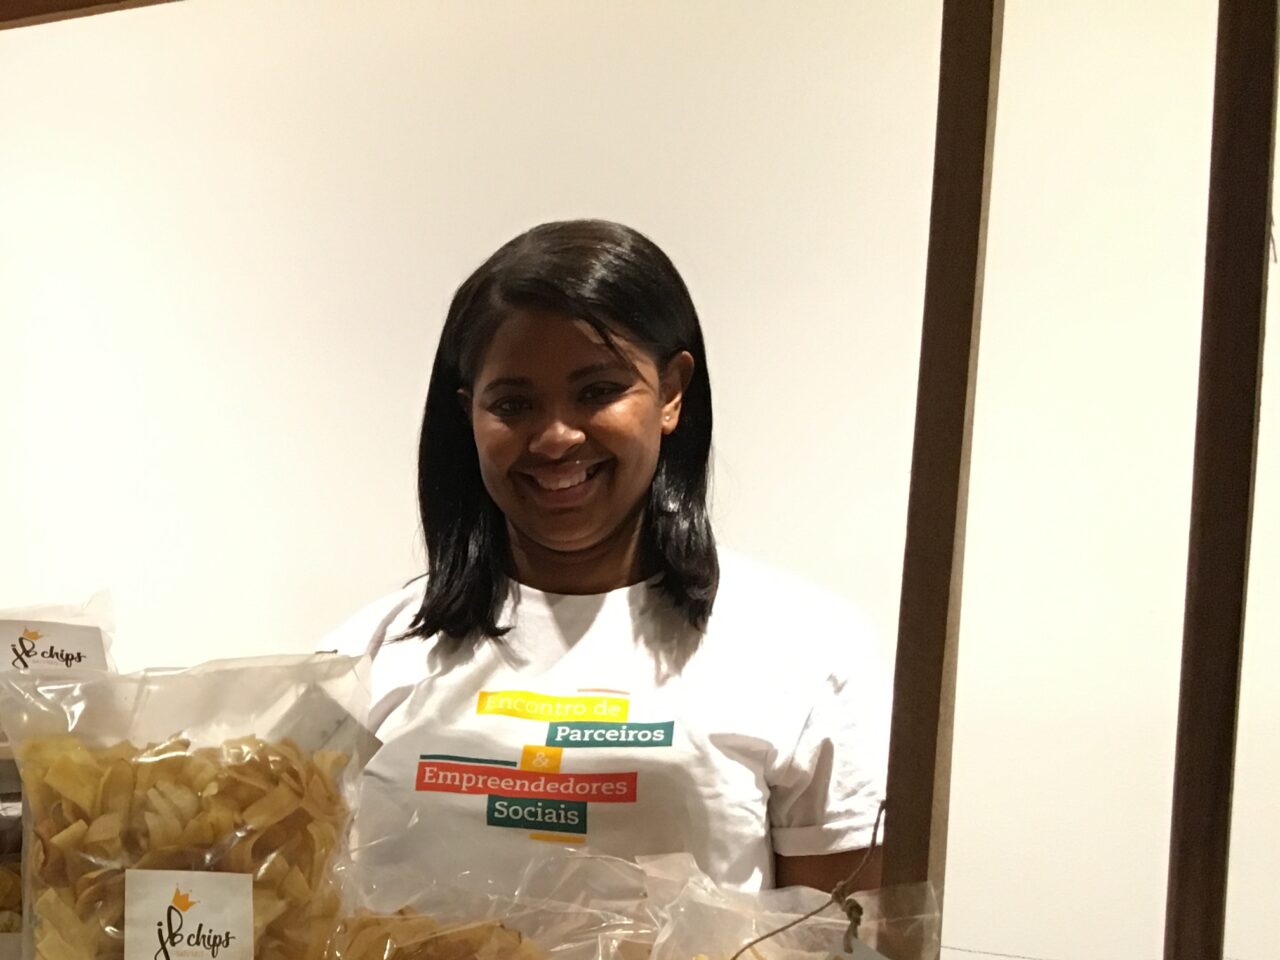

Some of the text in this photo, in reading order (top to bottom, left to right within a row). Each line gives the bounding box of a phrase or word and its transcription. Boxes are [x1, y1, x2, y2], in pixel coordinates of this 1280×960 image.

[11, 637, 86, 669] jb chips
[486, 695, 621, 716] Encontro de
[555, 726, 665, 742] Parceiros
[533, 752, 549, 767] &
[424, 767, 628, 795] Empreendedores
[494, 801, 579, 824] Sociais
[187, 923, 235, 958] chips
